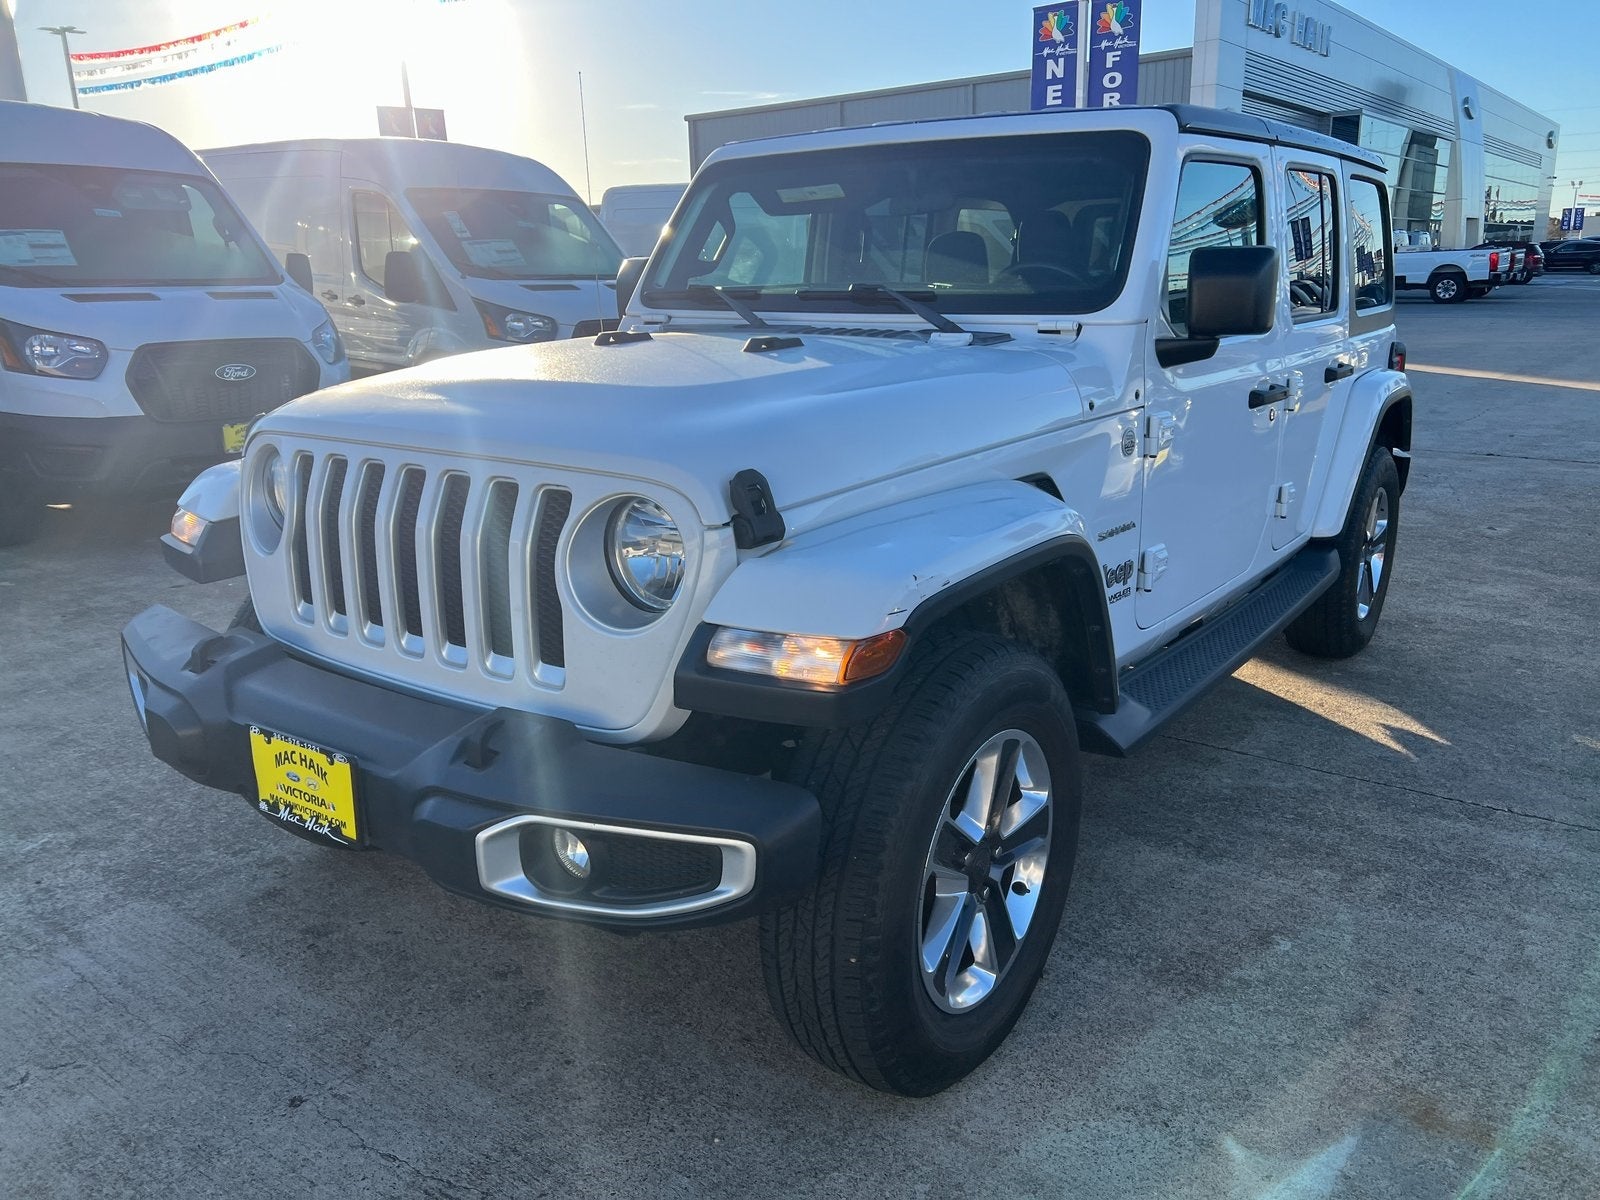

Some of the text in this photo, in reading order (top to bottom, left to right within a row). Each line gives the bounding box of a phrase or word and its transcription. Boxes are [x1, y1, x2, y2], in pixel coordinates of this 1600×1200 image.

[1291, 10, 1331, 57] HAIK
[223, 366, 249, 378] Ford
[274, 750, 297, 769] MAC
[299, 752, 329, 786] HAIK
[282, 783, 328, 809] VICTORIA
[278, 806, 337, 837] Mac Haik
